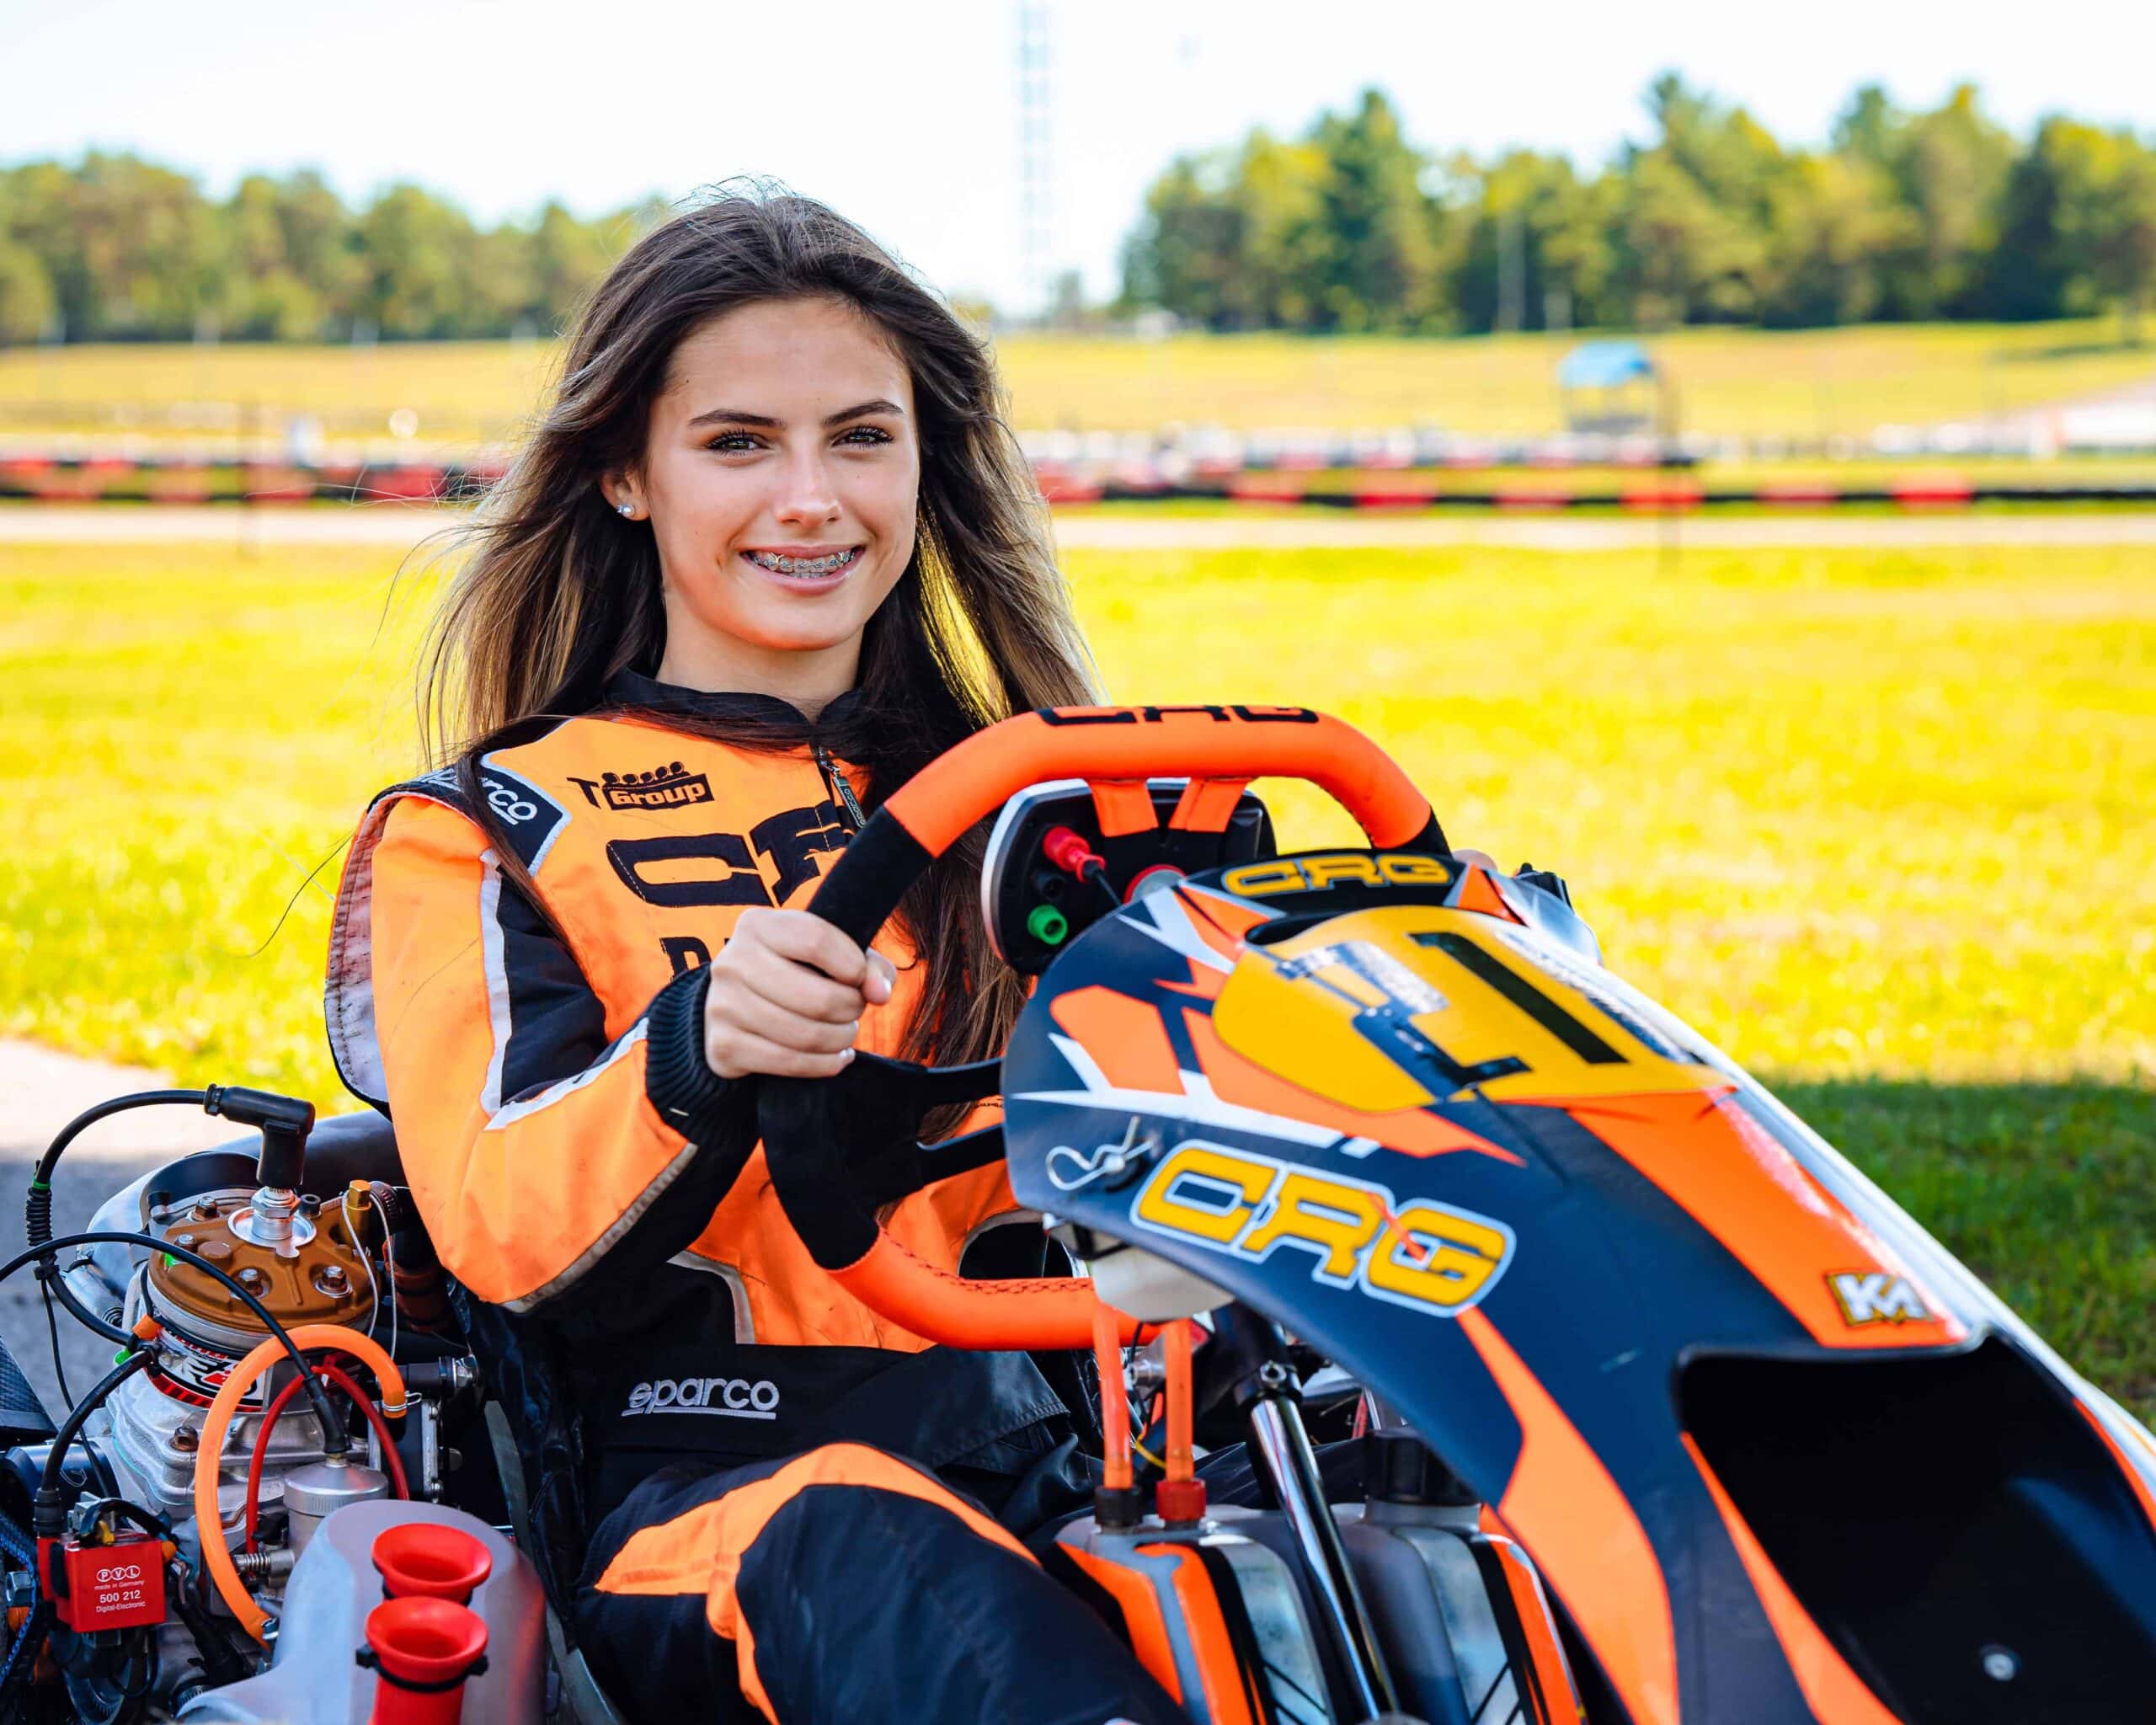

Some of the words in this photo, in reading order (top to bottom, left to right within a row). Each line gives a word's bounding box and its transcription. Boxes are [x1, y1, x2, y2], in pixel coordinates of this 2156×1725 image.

[606, 799, 852, 908] CR
[1223, 853, 1450, 897] CRG
[1133, 1143, 1513, 1313] CRG
[624, 1378, 780, 1415] sparco
[99, 1567, 138, 1581] PVL
[96, 1601, 146, 1613] Digital-Electronic
[99, 1593, 120, 1603] 500
[123, 1590, 141, 1600] 212
